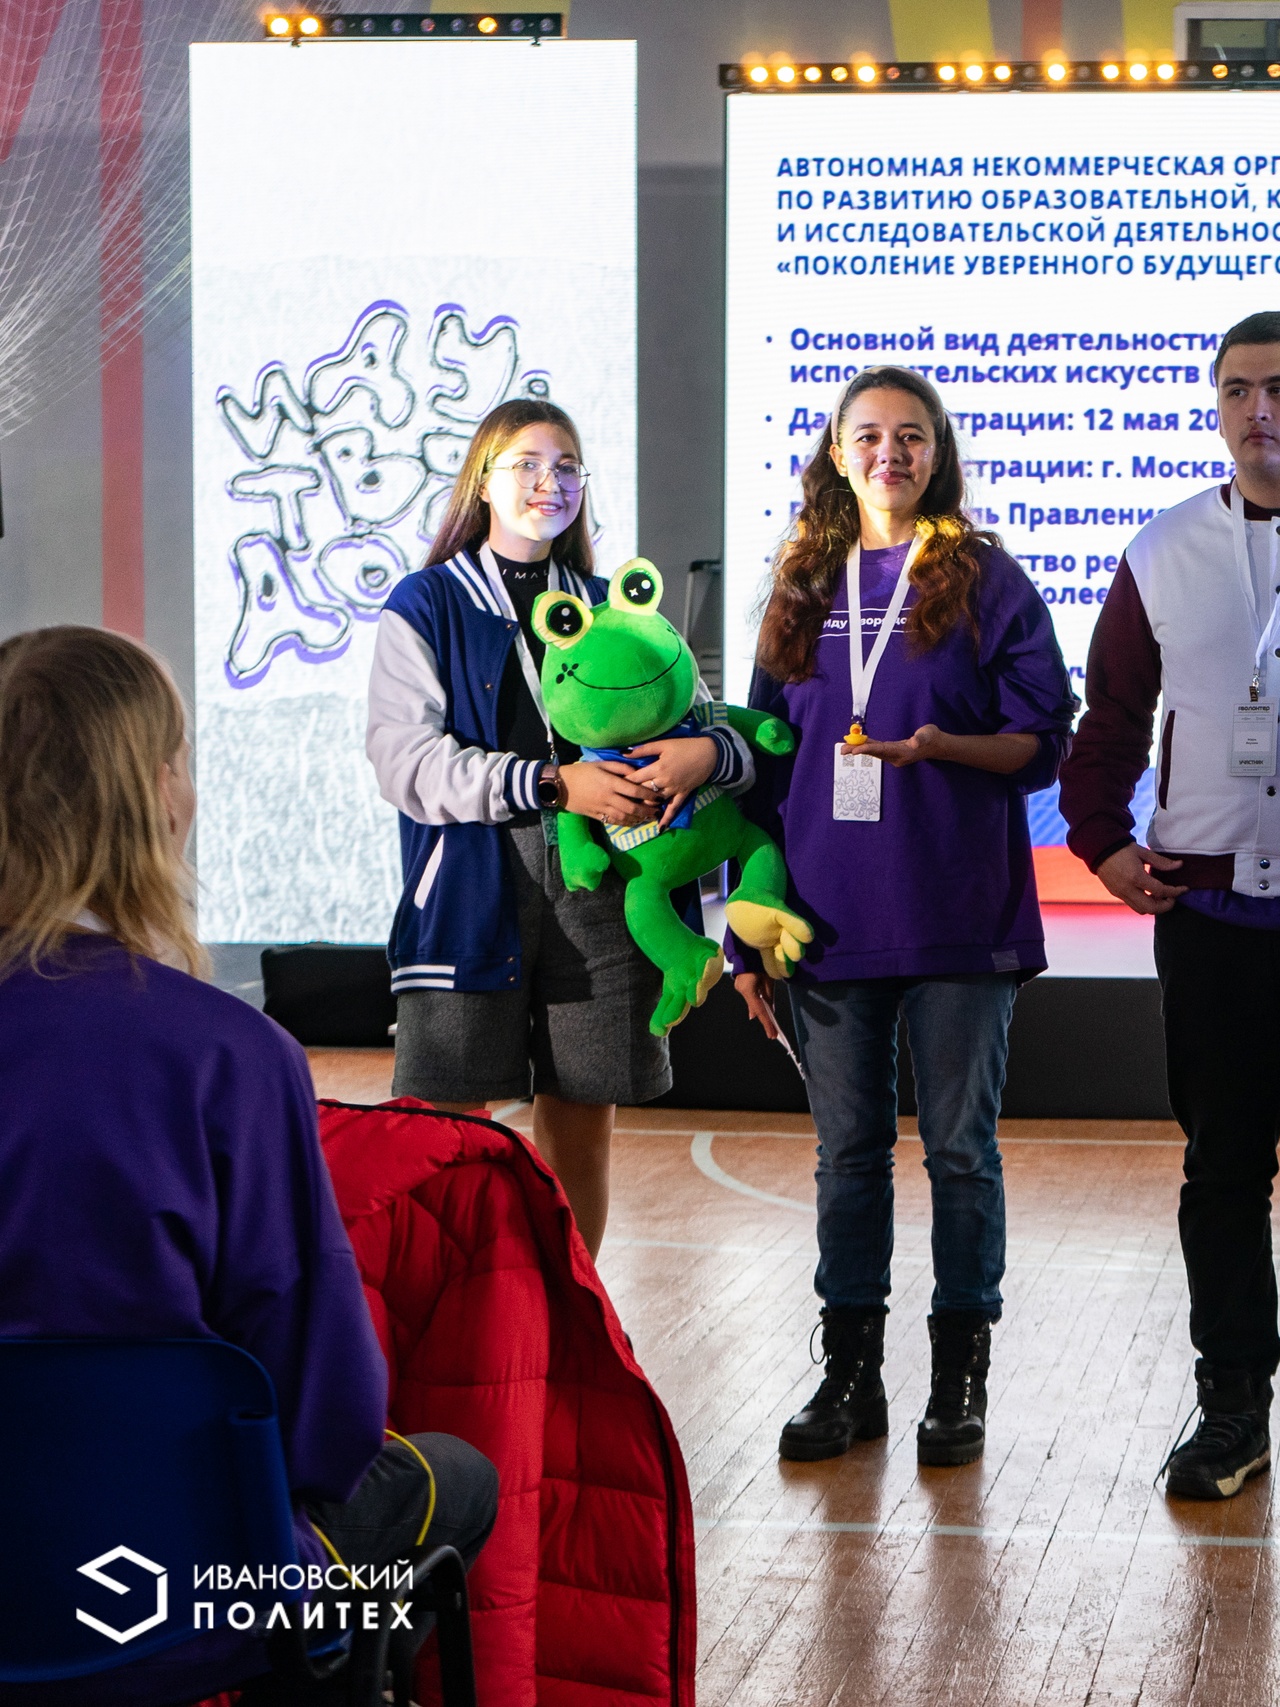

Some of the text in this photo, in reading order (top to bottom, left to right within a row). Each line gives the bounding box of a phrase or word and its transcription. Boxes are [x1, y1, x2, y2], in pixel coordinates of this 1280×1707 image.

[777, 157, 963, 177] АВТОНОМНАЯ
[973, 156, 1225, 177] НЕКОММЕРЧЕСКАЯ
[777, 190, 813, 210] ПО
[823, 189, 972, 210] РАЗВИТИЮ
[982, 182, 1257, 213] ОБРАЗОВАТЕЛЬНОЙ,
[777, 222, 795, 242] И
[806, 215, 1105, 248] ИССЛЕДОВАТЕЛЬСКОЙ
[777, 255, 955, 276] «ПОКОЛЕНИЕ
[964, 254, 1134, 276] УВЕРЕННОГО
[791, 326, 935, 351] Основной
[945, 333, 999, 356] вид
[791, 364, 1057, 383] испотельских
[1066, 364, 1200, 390] искусств
[952, 412, 1074, 437] трации:
[1084, 408, 1113, 431] 12
[1123, 412, 1180, 431] мая
[1189, 408, 1219, 431] 20
[965, 459, 1093, 485] трации:
[1103, 460, 1122, 478] г.
[1009, 502, 1167, 532] Правлени
[1034, 580, 1109, 605] олее
